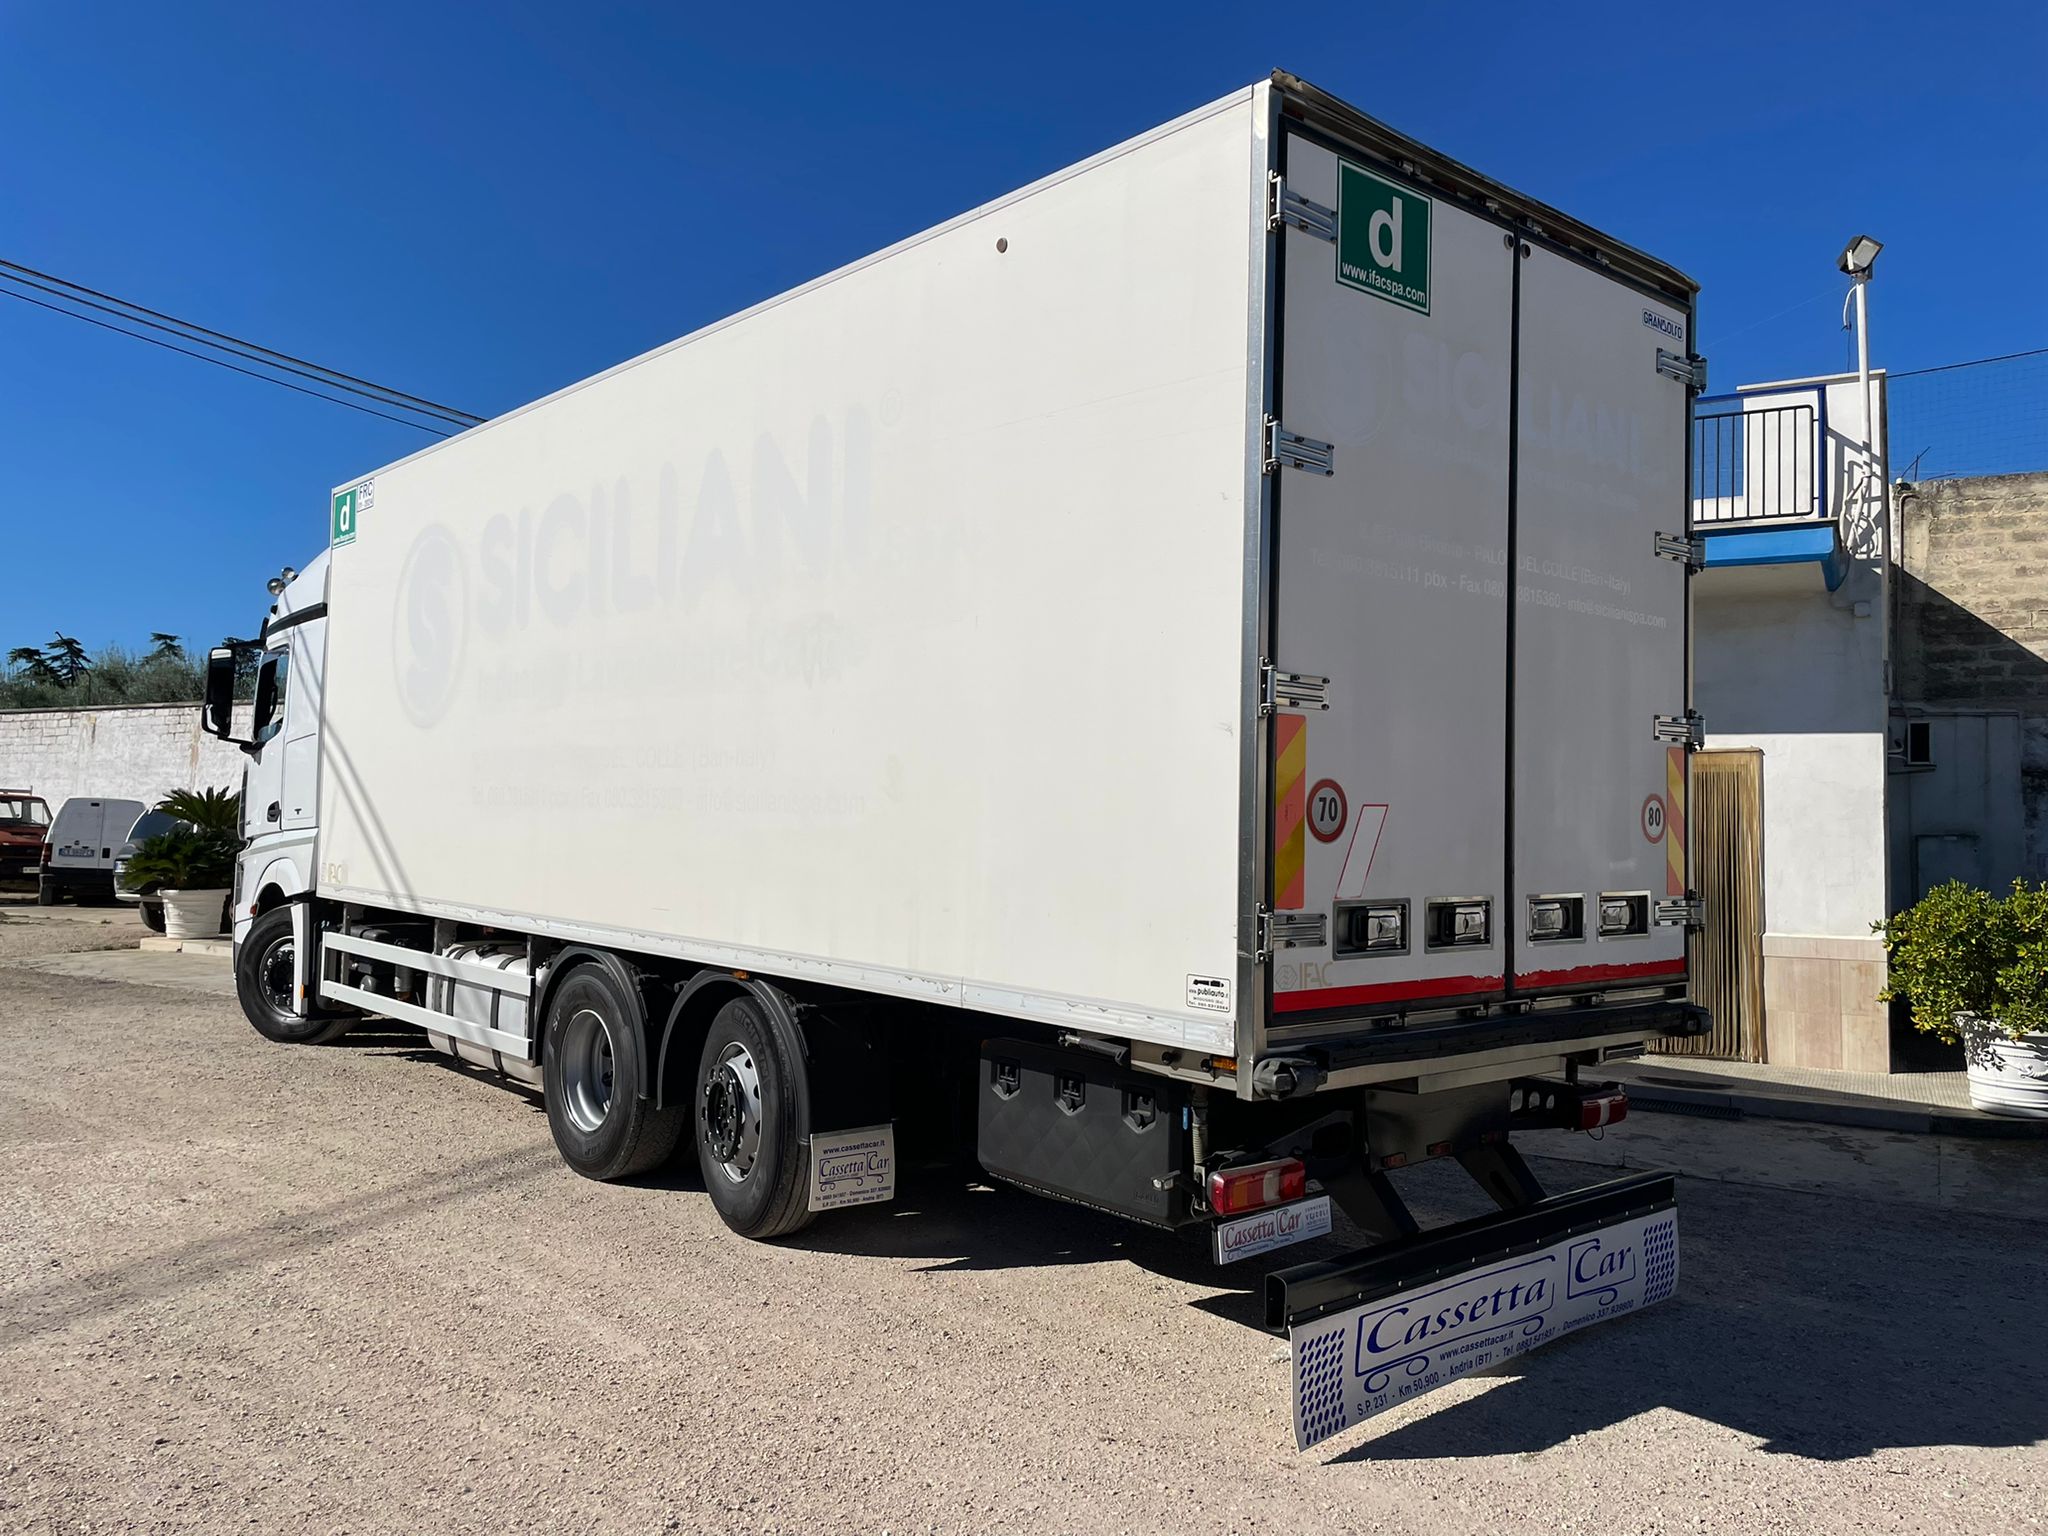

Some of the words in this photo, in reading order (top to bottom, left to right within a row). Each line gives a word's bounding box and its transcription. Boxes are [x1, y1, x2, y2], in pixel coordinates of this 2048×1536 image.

[1368, 195, 1403, 273] d
[1341, 260, 1426, 304] www.ifacspa.com
[480, 402, 872, 643] SICILIANI
[1424, 570, 1448, 590] pbx
[1459, 574, 1481, 595] Fax
[1318, 796, 1339, 823] 70
[1648, 806, 1661, 827] 80
[820, 1160, 865, 1178] Cassetta
[868, 1151, 890, 1171] Car
[822, 1139, 885, 1155] www.cassettacar.it
[1225, 1220, 1276, 1249] Cassetta
[1279, 1209, 1302, 1233] Car
[1366, 1277, 1547, 1354] Cassetta
[1574, 1244, 1632, 1284] Car
[1374, 1393, 1388, 1409] 231
[1398, 1384, 1413, 1398] Km
[1413, 1372, 1440, 1391] 50,900
[1449, 1360, 1473, 1377] Andria
[1475, 1352, 1493, 1368] (BT)
[1562, 1312, 1596, 1332] Domenico
[1439, 1329, 1514, 1362] www.cassettacar.it
